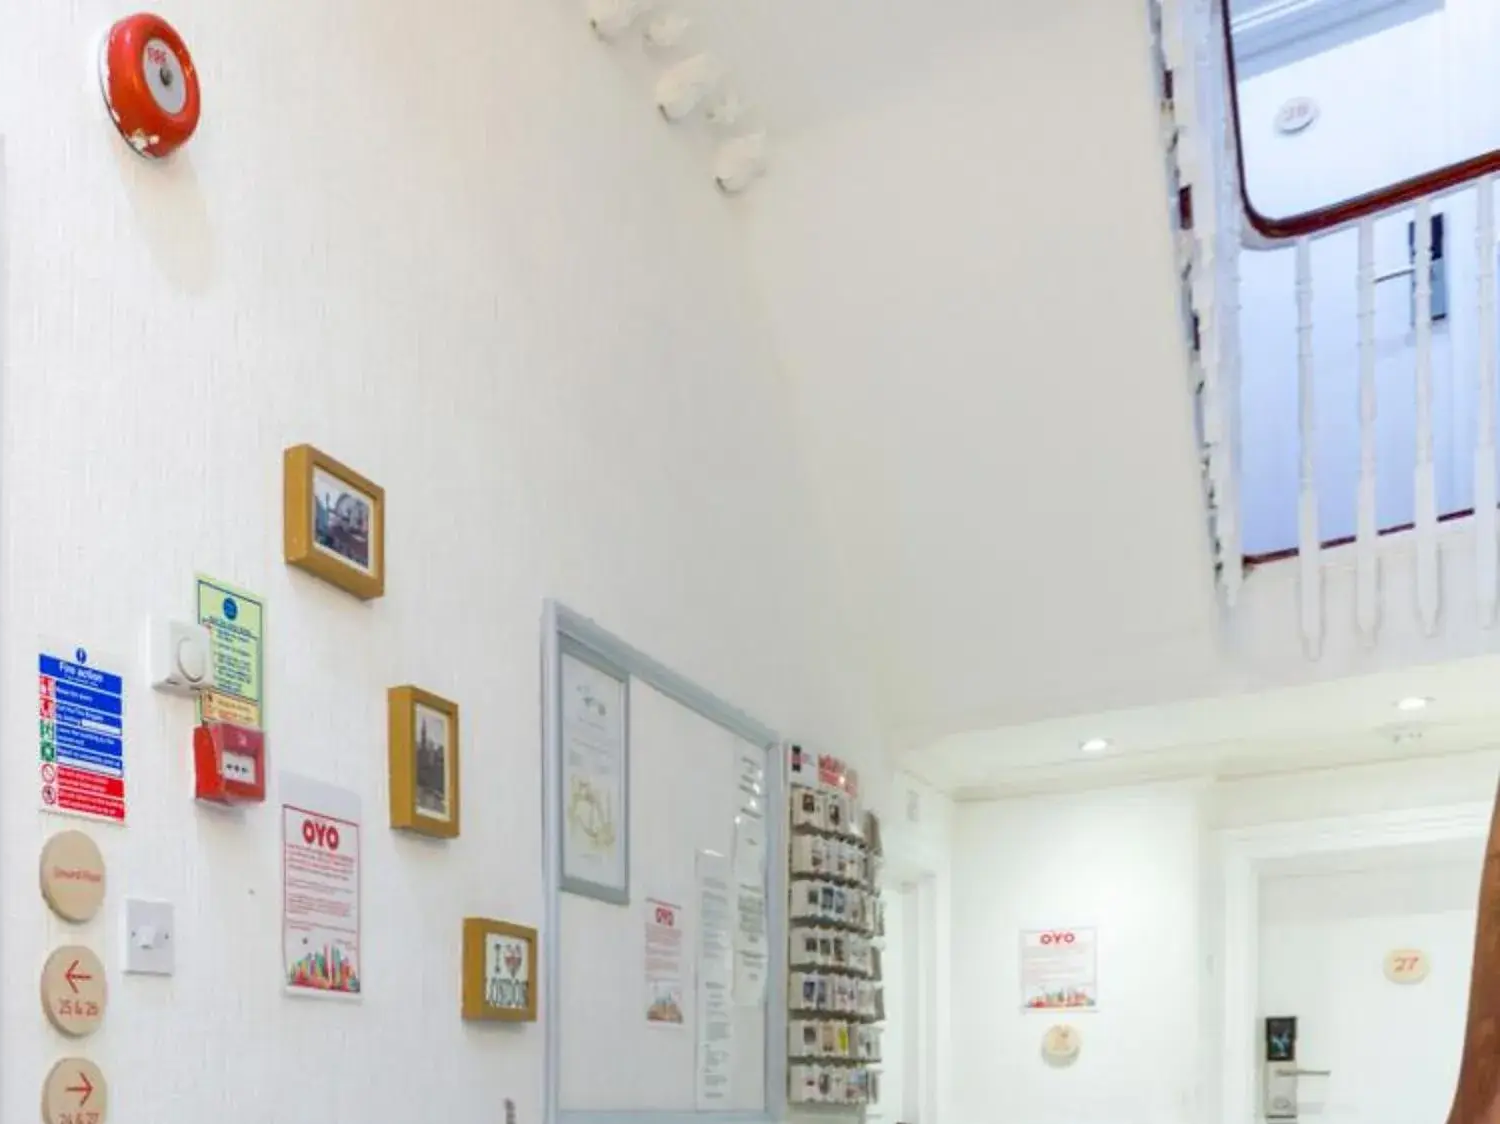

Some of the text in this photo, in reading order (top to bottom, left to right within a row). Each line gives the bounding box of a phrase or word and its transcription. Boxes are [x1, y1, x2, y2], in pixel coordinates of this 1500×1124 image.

[302, 819, 340, 850] OYO
[1040, 933, 1075, 945] OYO
[1393, 956, 1420, 973] 27
